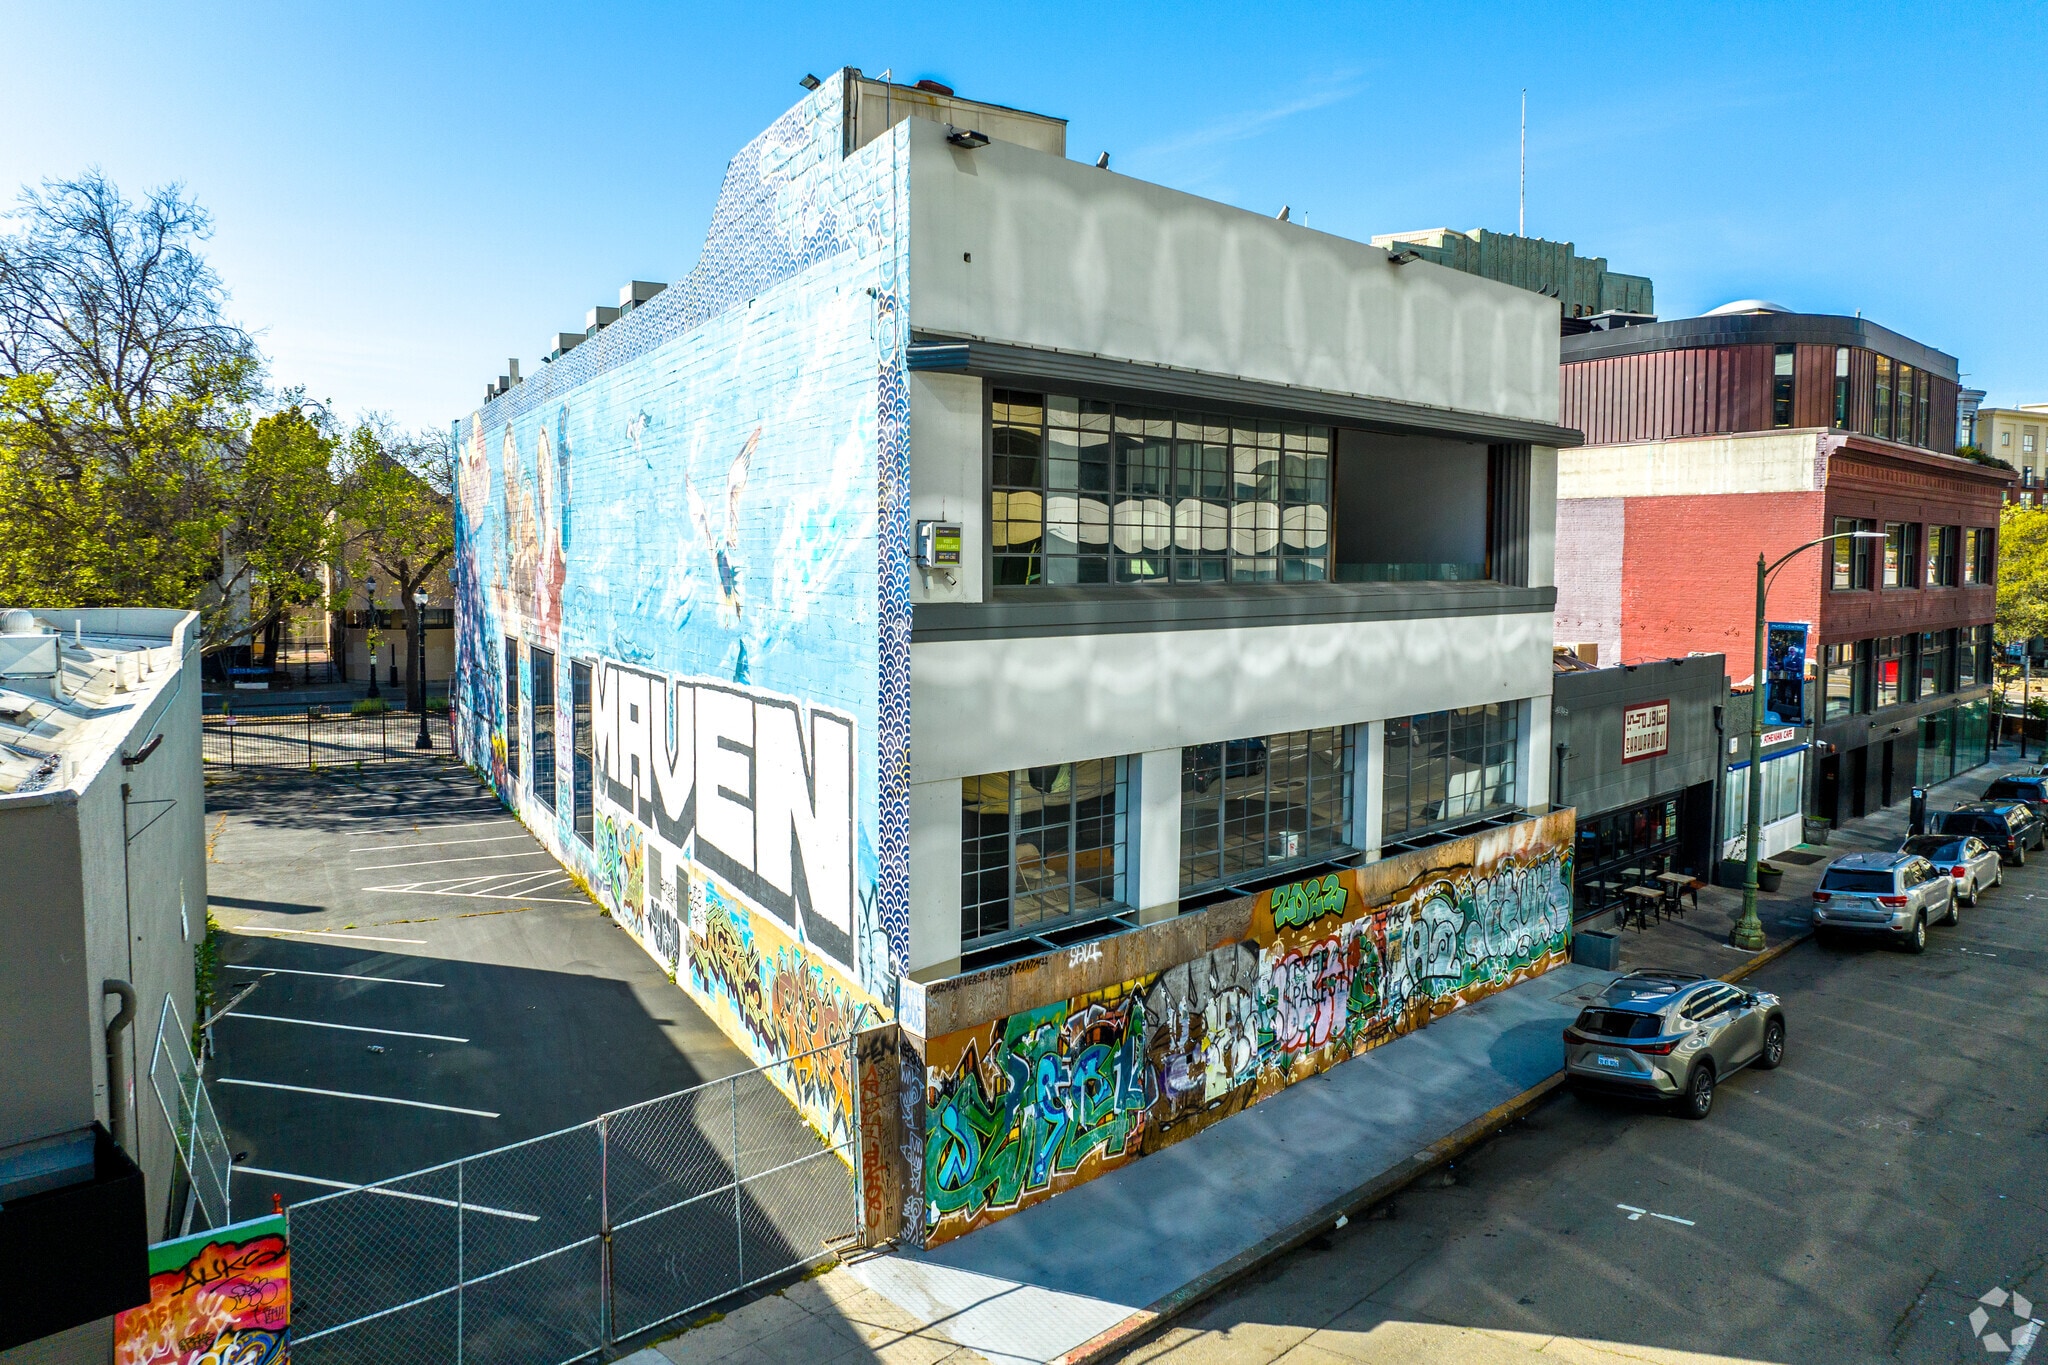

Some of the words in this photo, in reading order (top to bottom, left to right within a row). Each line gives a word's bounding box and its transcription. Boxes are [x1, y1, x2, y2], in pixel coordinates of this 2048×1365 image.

[1626, 730, 1666, 754] SHAWARMAJI
[587, 656, 855, 972] MAVEN
[1271, 873, 1348, 934] 2022
